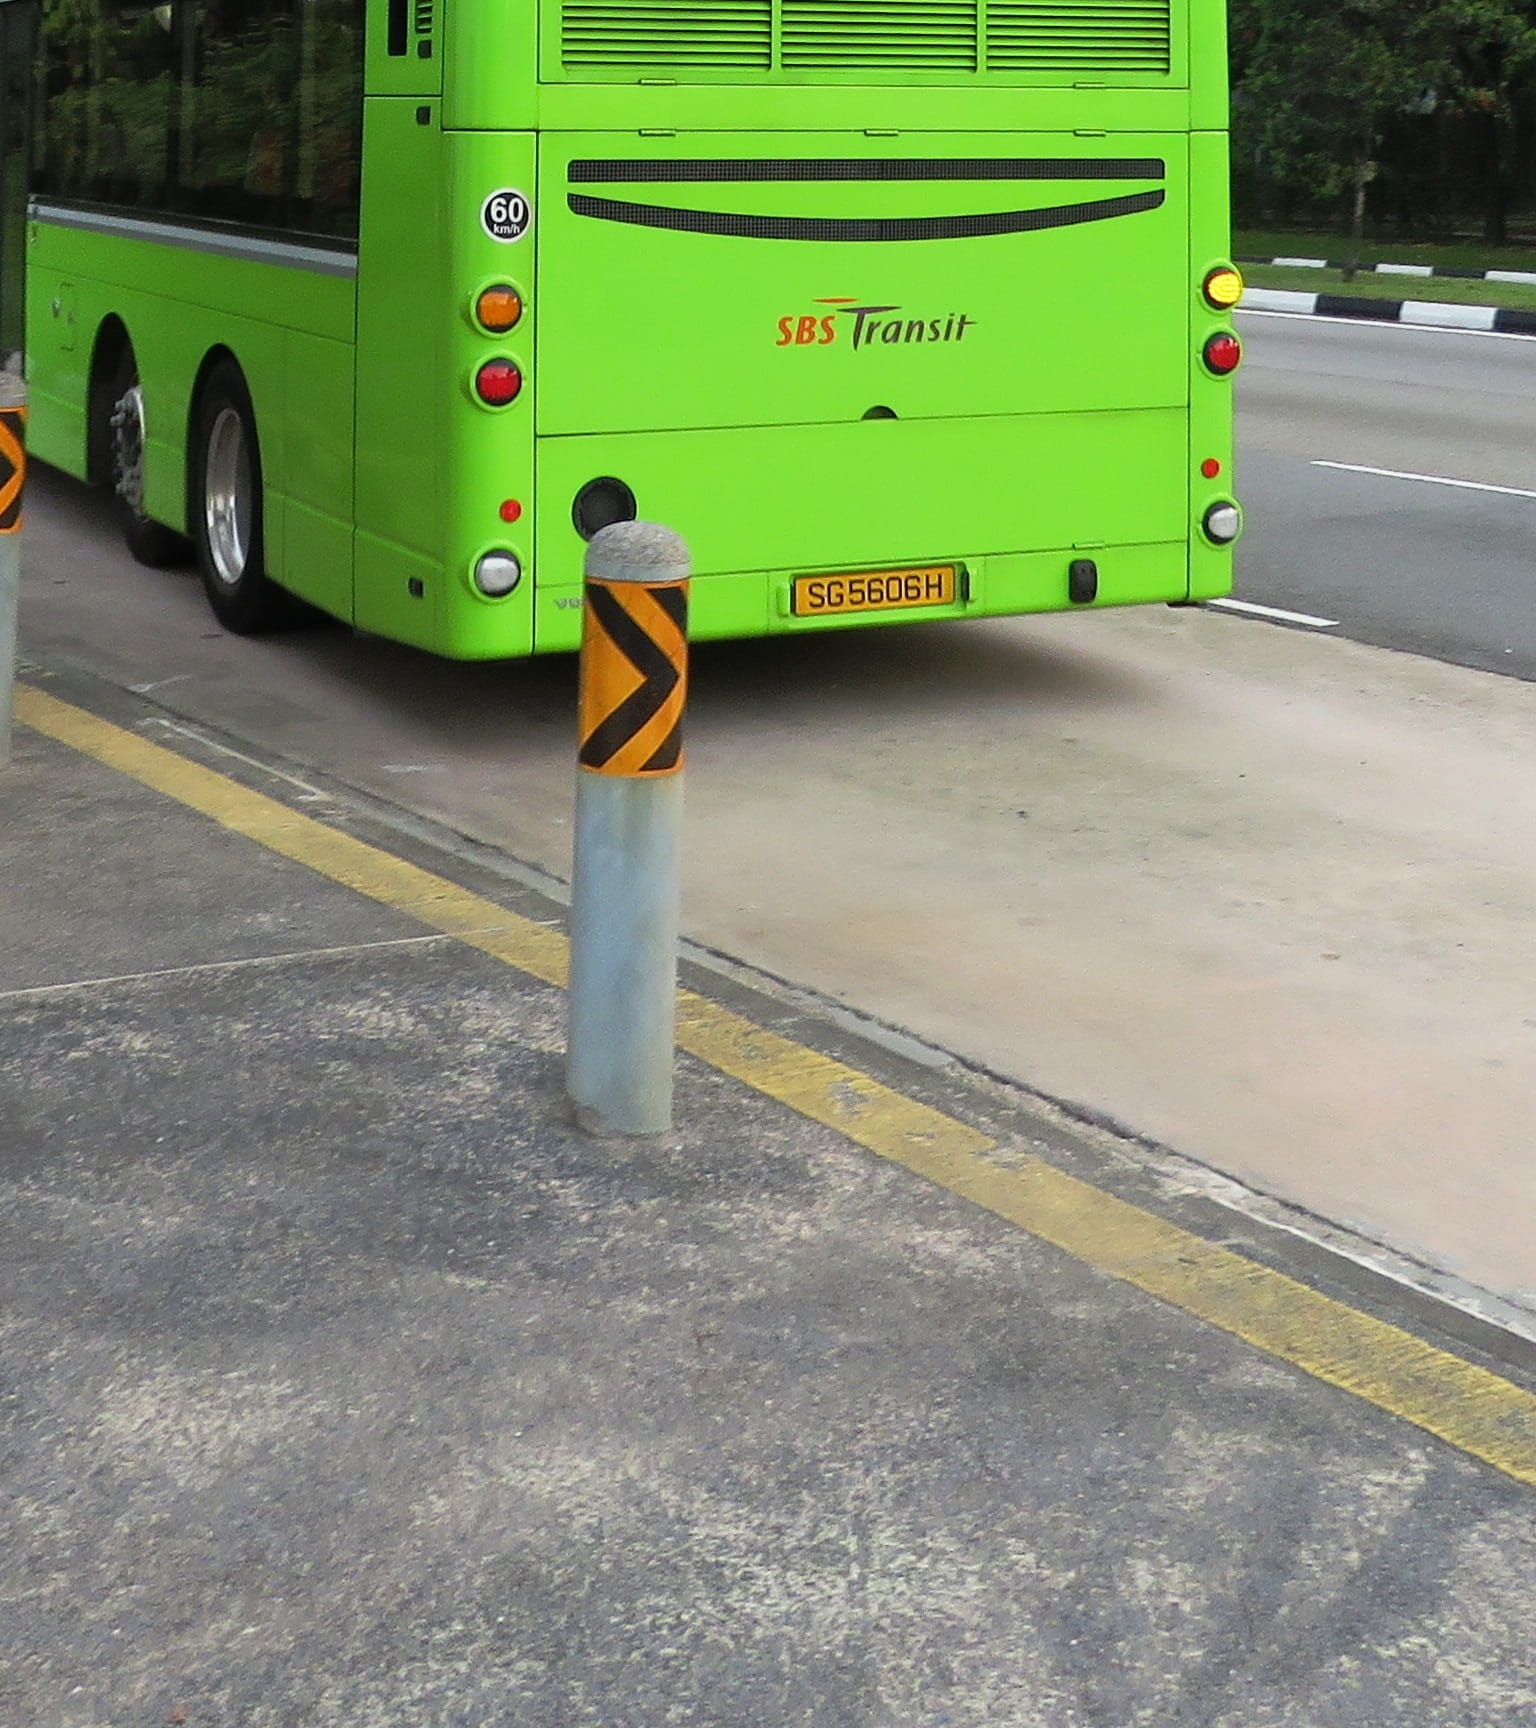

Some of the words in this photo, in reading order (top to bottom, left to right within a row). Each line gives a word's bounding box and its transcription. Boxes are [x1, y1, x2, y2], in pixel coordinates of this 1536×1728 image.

[490, 197, 524, 223] 60
[493, 223, 520, 234] km/h
[775, 315, 836, 346] SBS
[836, 306, 979, 352] Transit
[808, 573, 943, 609] SG5606H
